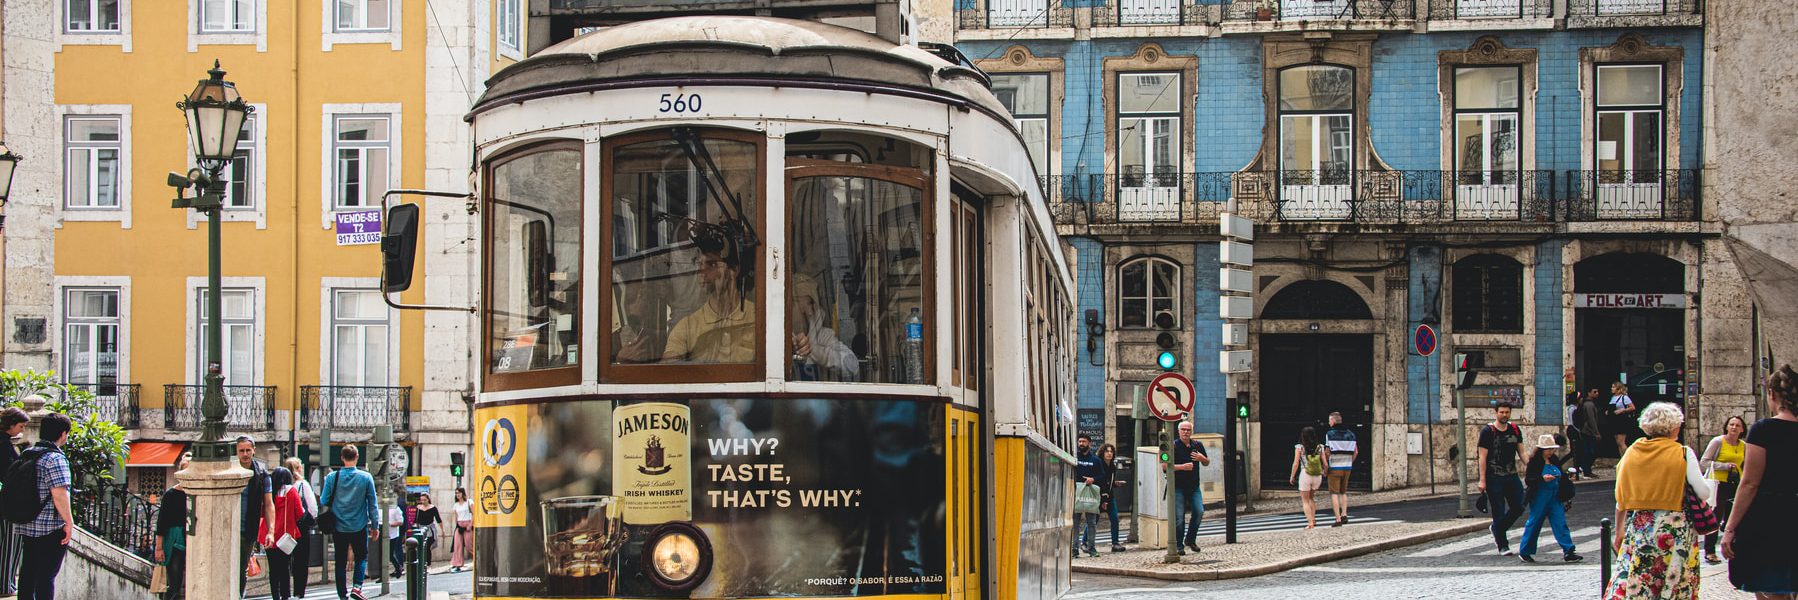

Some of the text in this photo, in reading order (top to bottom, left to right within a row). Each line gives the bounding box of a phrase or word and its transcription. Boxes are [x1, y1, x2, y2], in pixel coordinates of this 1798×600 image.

[659, 93, 702, 113] 560
[338, 212, 379, 223] VENDE-SE
[352, 223, 365, 233] T2
[338, 233, 380, 244] 917 333 035
[1586, 294, 1624, 307] FOLK
[1637, 294, 1663, 307] ART
[498, 356, 512, 370] 08
[618, 413, 689, 438] JAMESON
[708, 438, 779, 456] WHY?
[708, 464, 790, 485] TASTE,
[648, 489, 684, 497] WHISKEY
[708, 490, 791, 508] THAT'S
[849, 577, 856, 585] O
[888, 574, 894, 584] É
[894, 576, 914, 584] ESSA
[921, 573, 943, 583] RAZÃO
